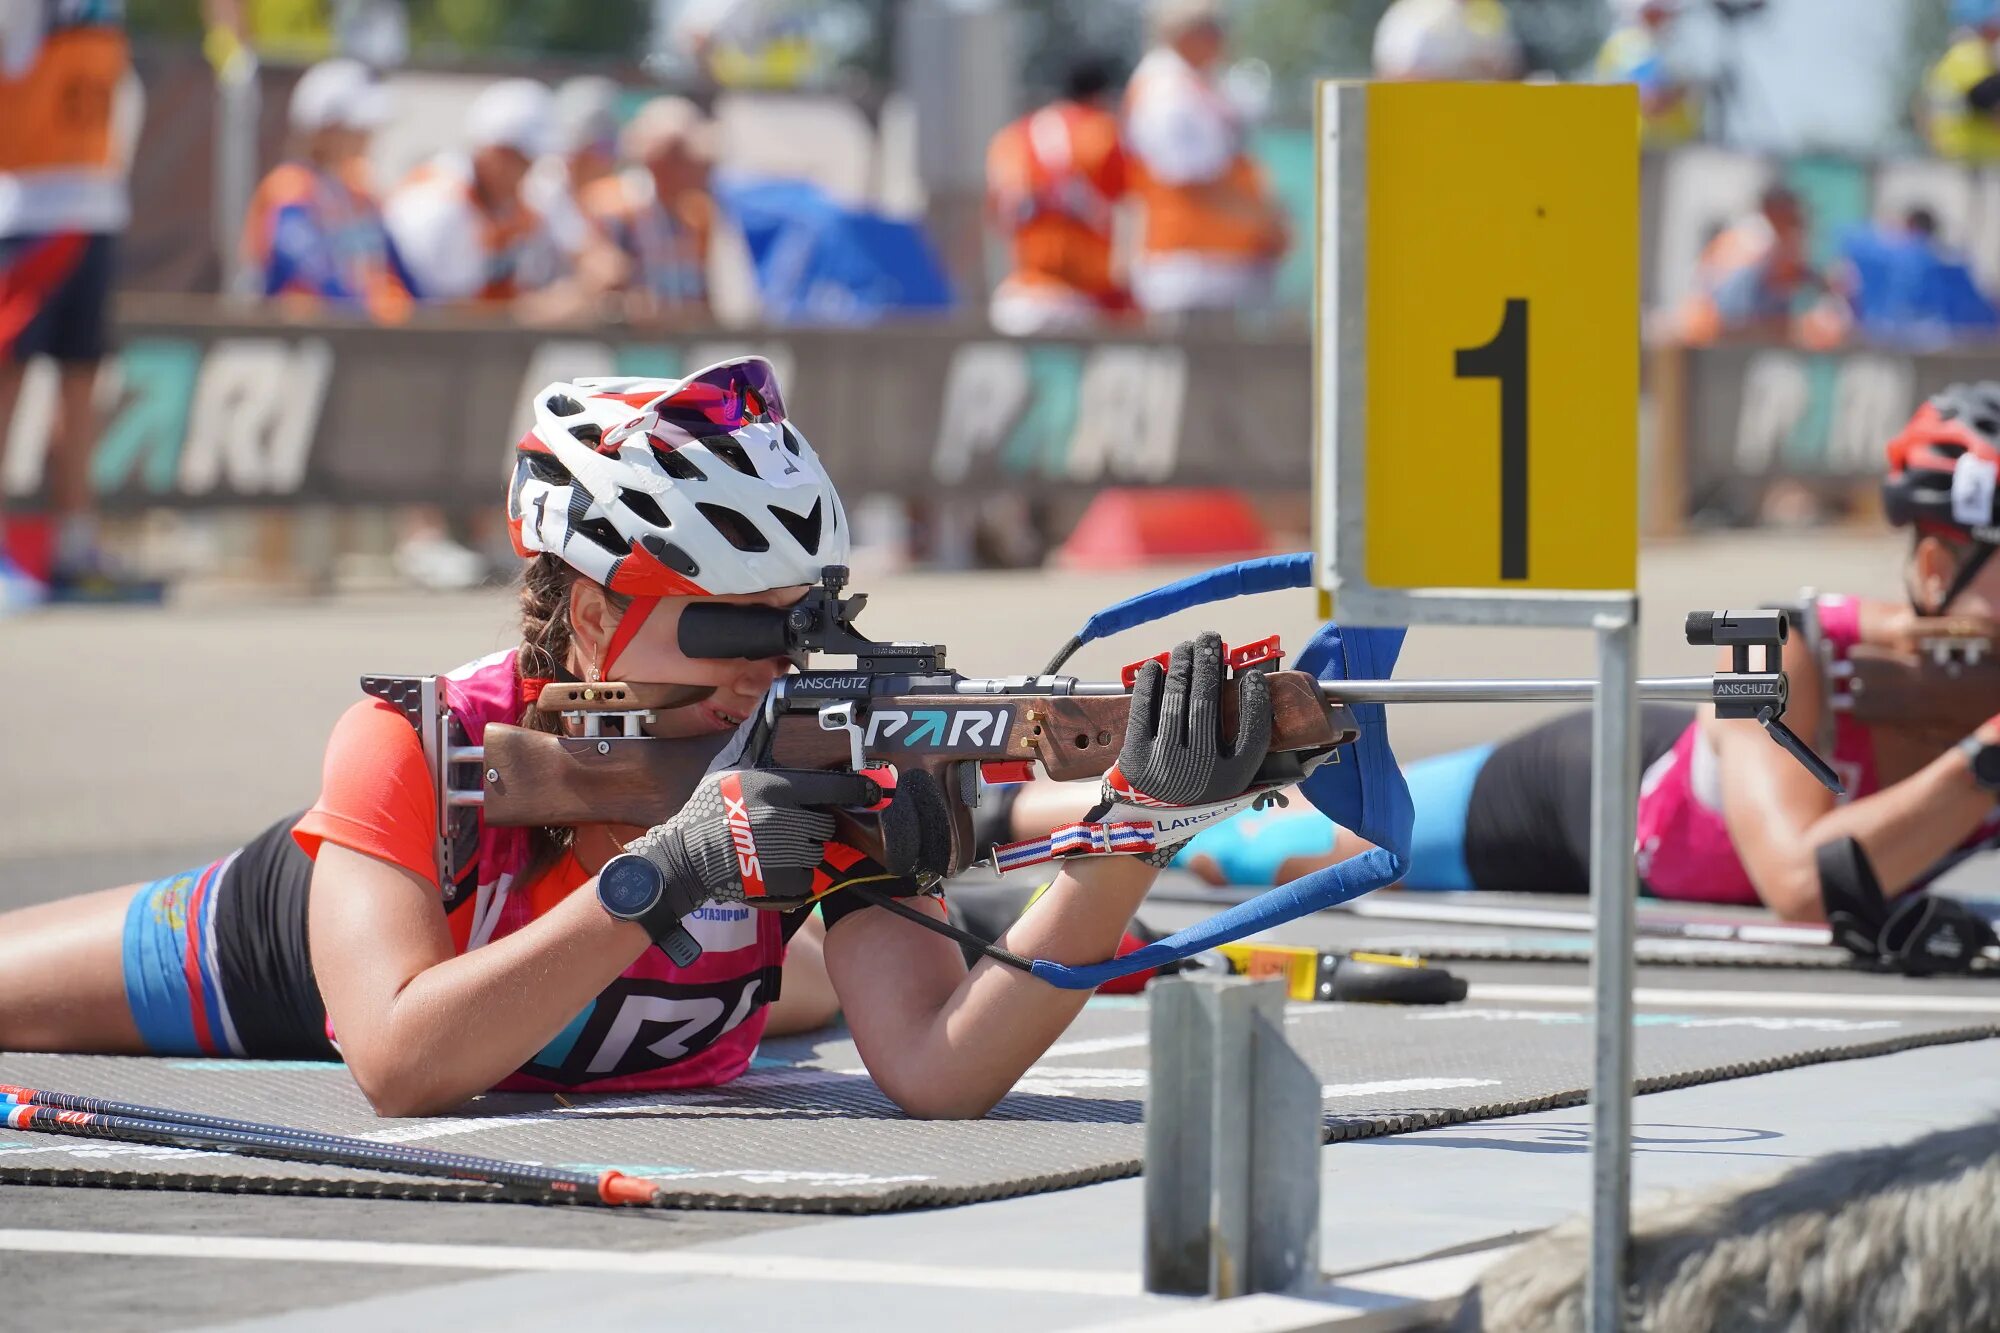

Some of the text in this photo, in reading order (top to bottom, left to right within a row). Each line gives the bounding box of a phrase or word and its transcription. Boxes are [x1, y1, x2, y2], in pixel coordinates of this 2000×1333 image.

[931, 342, 1188, 484] PARI
[1454, 297, 1529, 580] 1
[532, 490, 549, 544] 1
[864, 710, 1009, 747] PARI
[1156, 803, 1238, 832] LARSEN
[704, 907, 749, 921] ГАЗПРОМ
